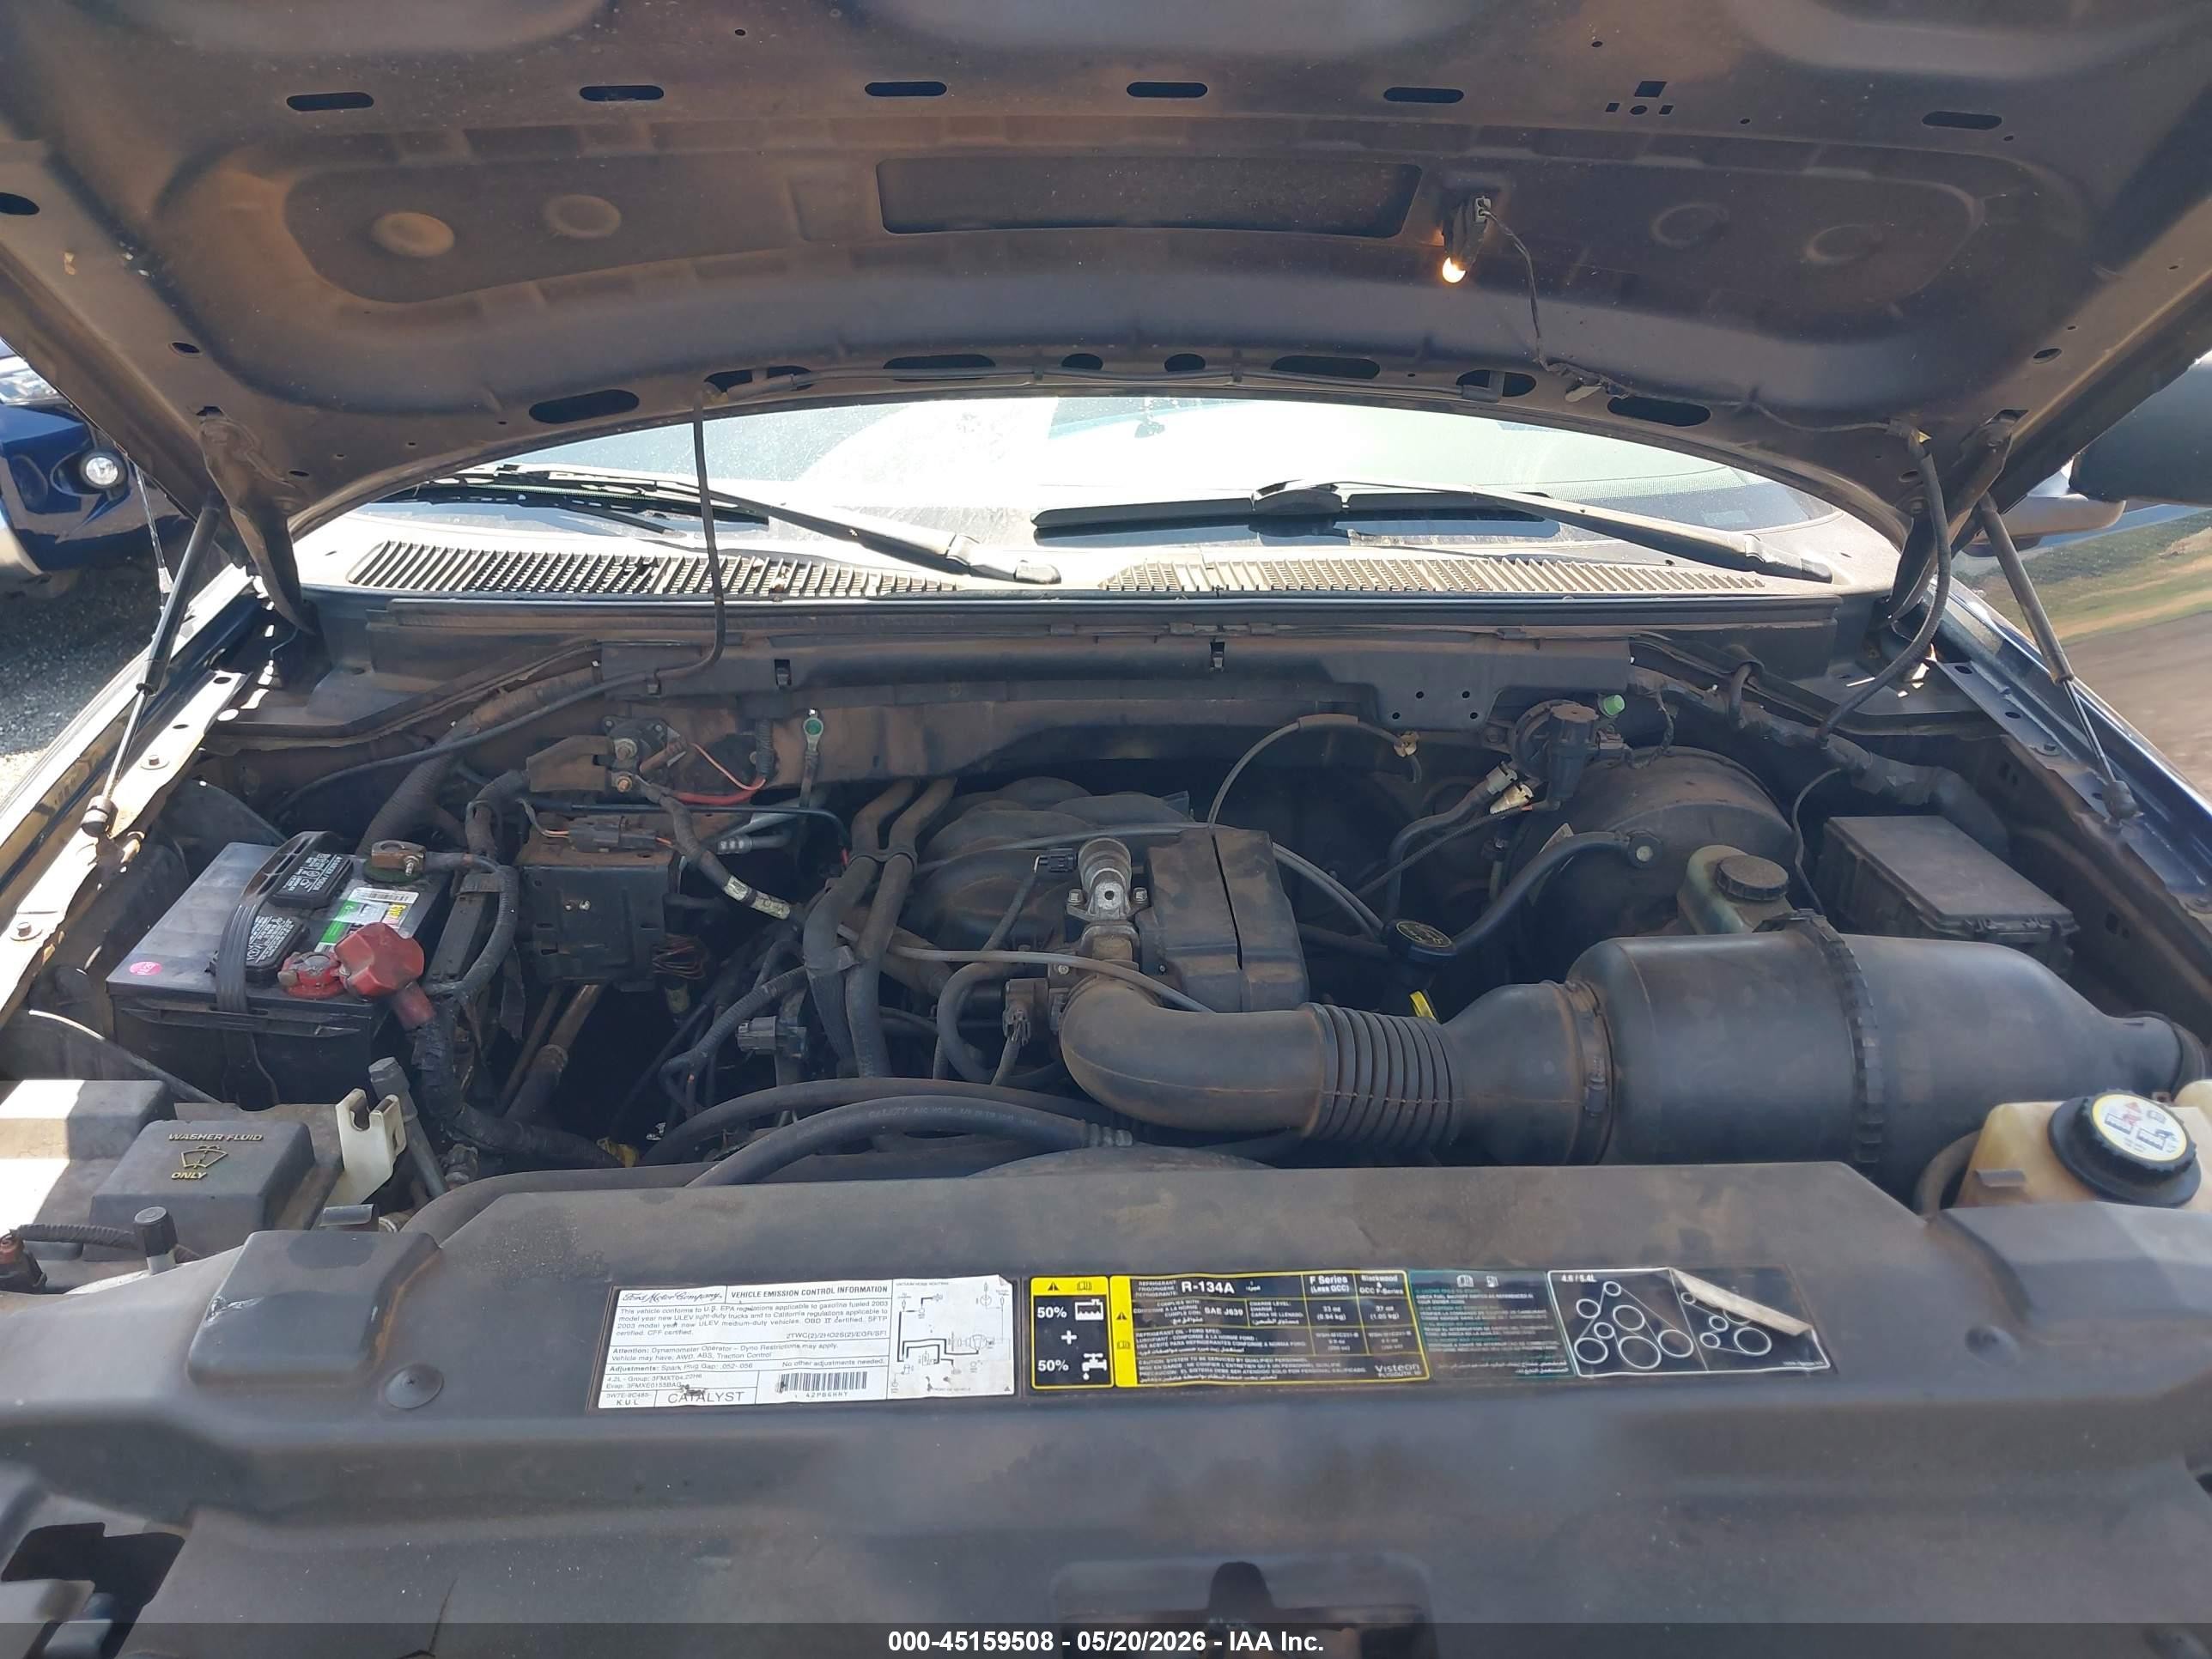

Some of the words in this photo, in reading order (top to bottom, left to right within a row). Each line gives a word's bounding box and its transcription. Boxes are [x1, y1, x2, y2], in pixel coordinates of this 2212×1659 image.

[171, 1171, 208, 1180] ONLY
[1318, 1275, 1349, 1284] Series
[1579, 1273, 1597, 1283] 5.4L
[763, 1289, 799, 1297] EMISSION
[800, 1287, 836, 1297] CONTROL
[837, 1285, 888, 1294] INFORMATION
[1181, 1281, 1236, 1295] R-134A
[1310, 1283, 1330, 1293] (Less
[736, 1304, 774, 1313] regulations
[775, 1303, 810, 1311] applicable
[819, 1302, 848, 1310] gasoline
[773, 1310, 805, 1318] California
[806, 1309, 844, 1318] regulations
[846, 1308, 880, 1317] applicable
[1037, 1306, 1067, 1319] 50%
[1204, 1307, 1223, 1316] SAE
[1224, 1307, 1244, 1316] J639
[721, 1319, 768, 1328] medium-duty
[701, 1345, 732, 1353] Operator
[817, 1342, 839, 1351] apply.
[609, 1364, 659, 1373] Adjustments:
[660, 1364, 682, 1372] Spark
[813, 1358, 856, 1368] adjustments
[1037, 1359, 1069, 1372] 50%
[1374, 1363, 1420, 1374] Visteon
[667, 1391, 744, 1404] CATALYST
